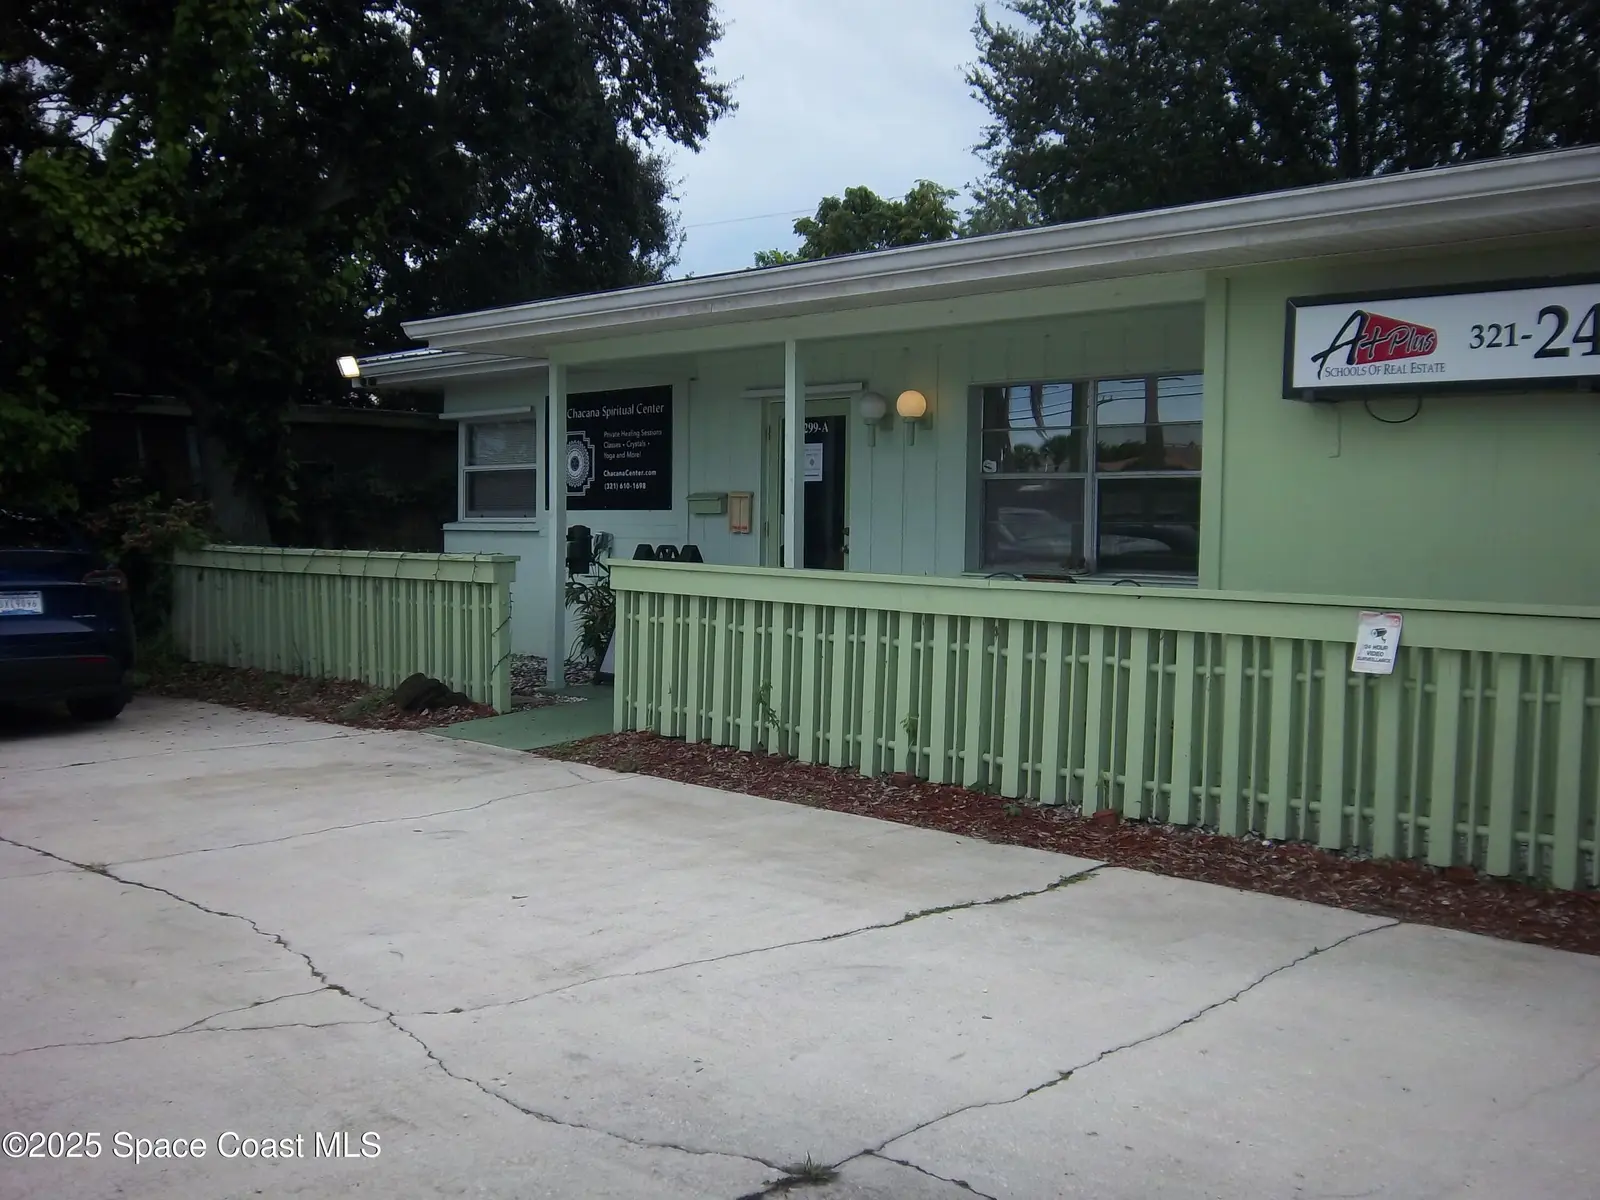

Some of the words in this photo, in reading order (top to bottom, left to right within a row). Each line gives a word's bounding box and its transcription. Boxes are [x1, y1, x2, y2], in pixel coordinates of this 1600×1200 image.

[567, 408, 600, 419] Chacana
[602, 404, 635, 419] Spiritual
[636, 403, 665, 414] Center
[603, 452, 615, 460] Yoga
[603, 469, 657, 477] ChacanaCenter.com
[604, 482, 619, 490] (321)
[619, 482, 647, 490] 610-1698
